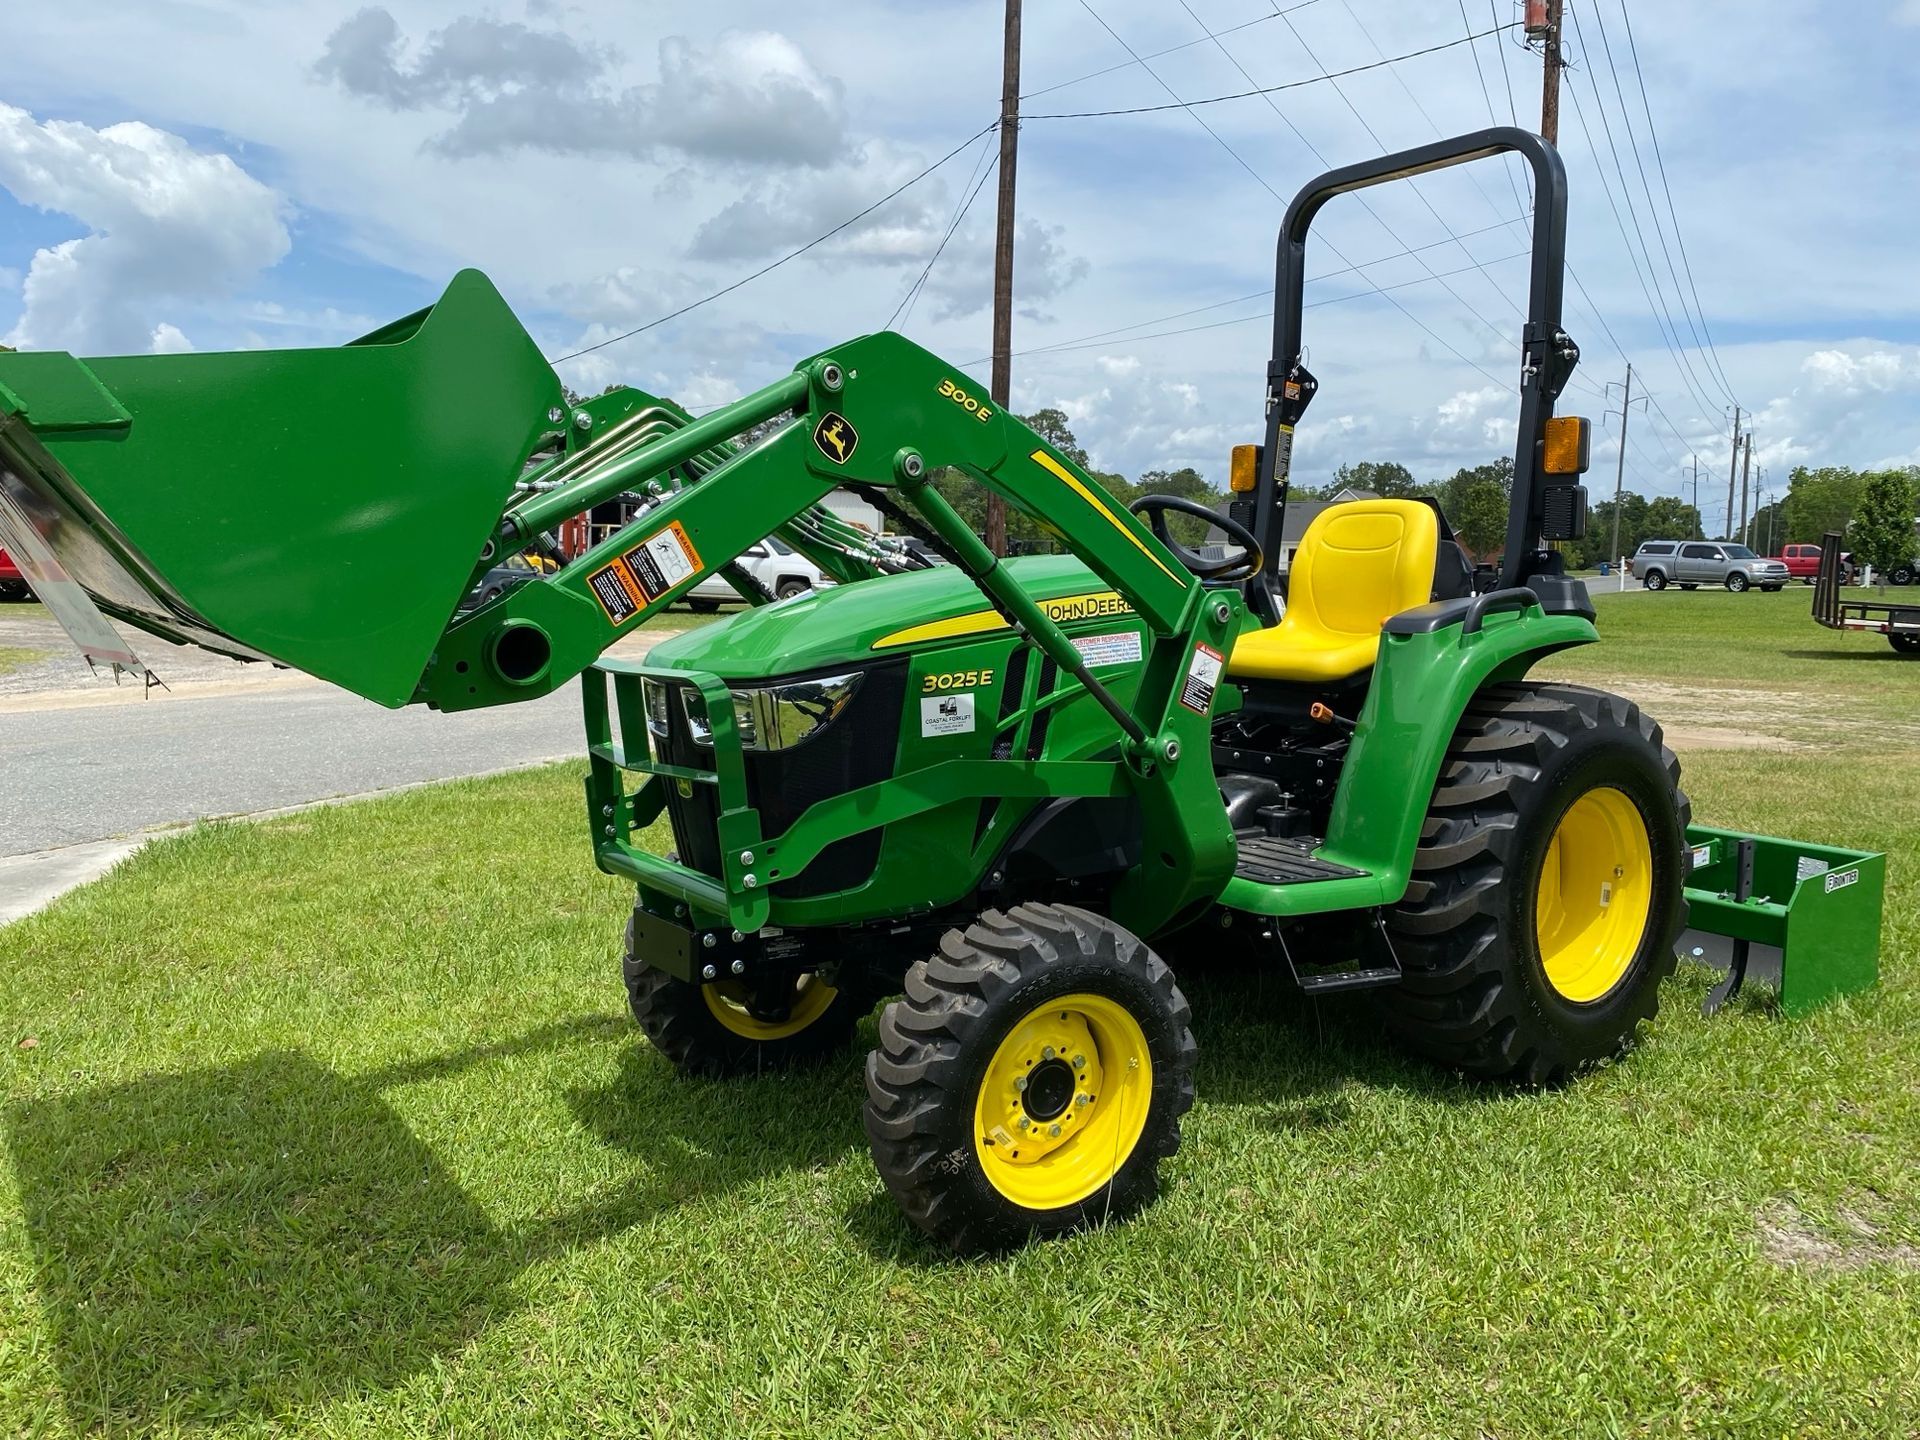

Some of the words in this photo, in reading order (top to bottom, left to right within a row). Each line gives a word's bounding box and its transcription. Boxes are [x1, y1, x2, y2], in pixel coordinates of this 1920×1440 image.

[938, 380, 993, 421] 300E
[679, 534, 700, 567] WARNING
[620, 572, 642, 605] WARNING
[1046, 602, 1084, 620] JOHN
[1071, 638, 1100, 647] CUSTOMER
[925, 717, 948, 725] COASTAL
[949, 714, 971, 722] FORKLIFT
